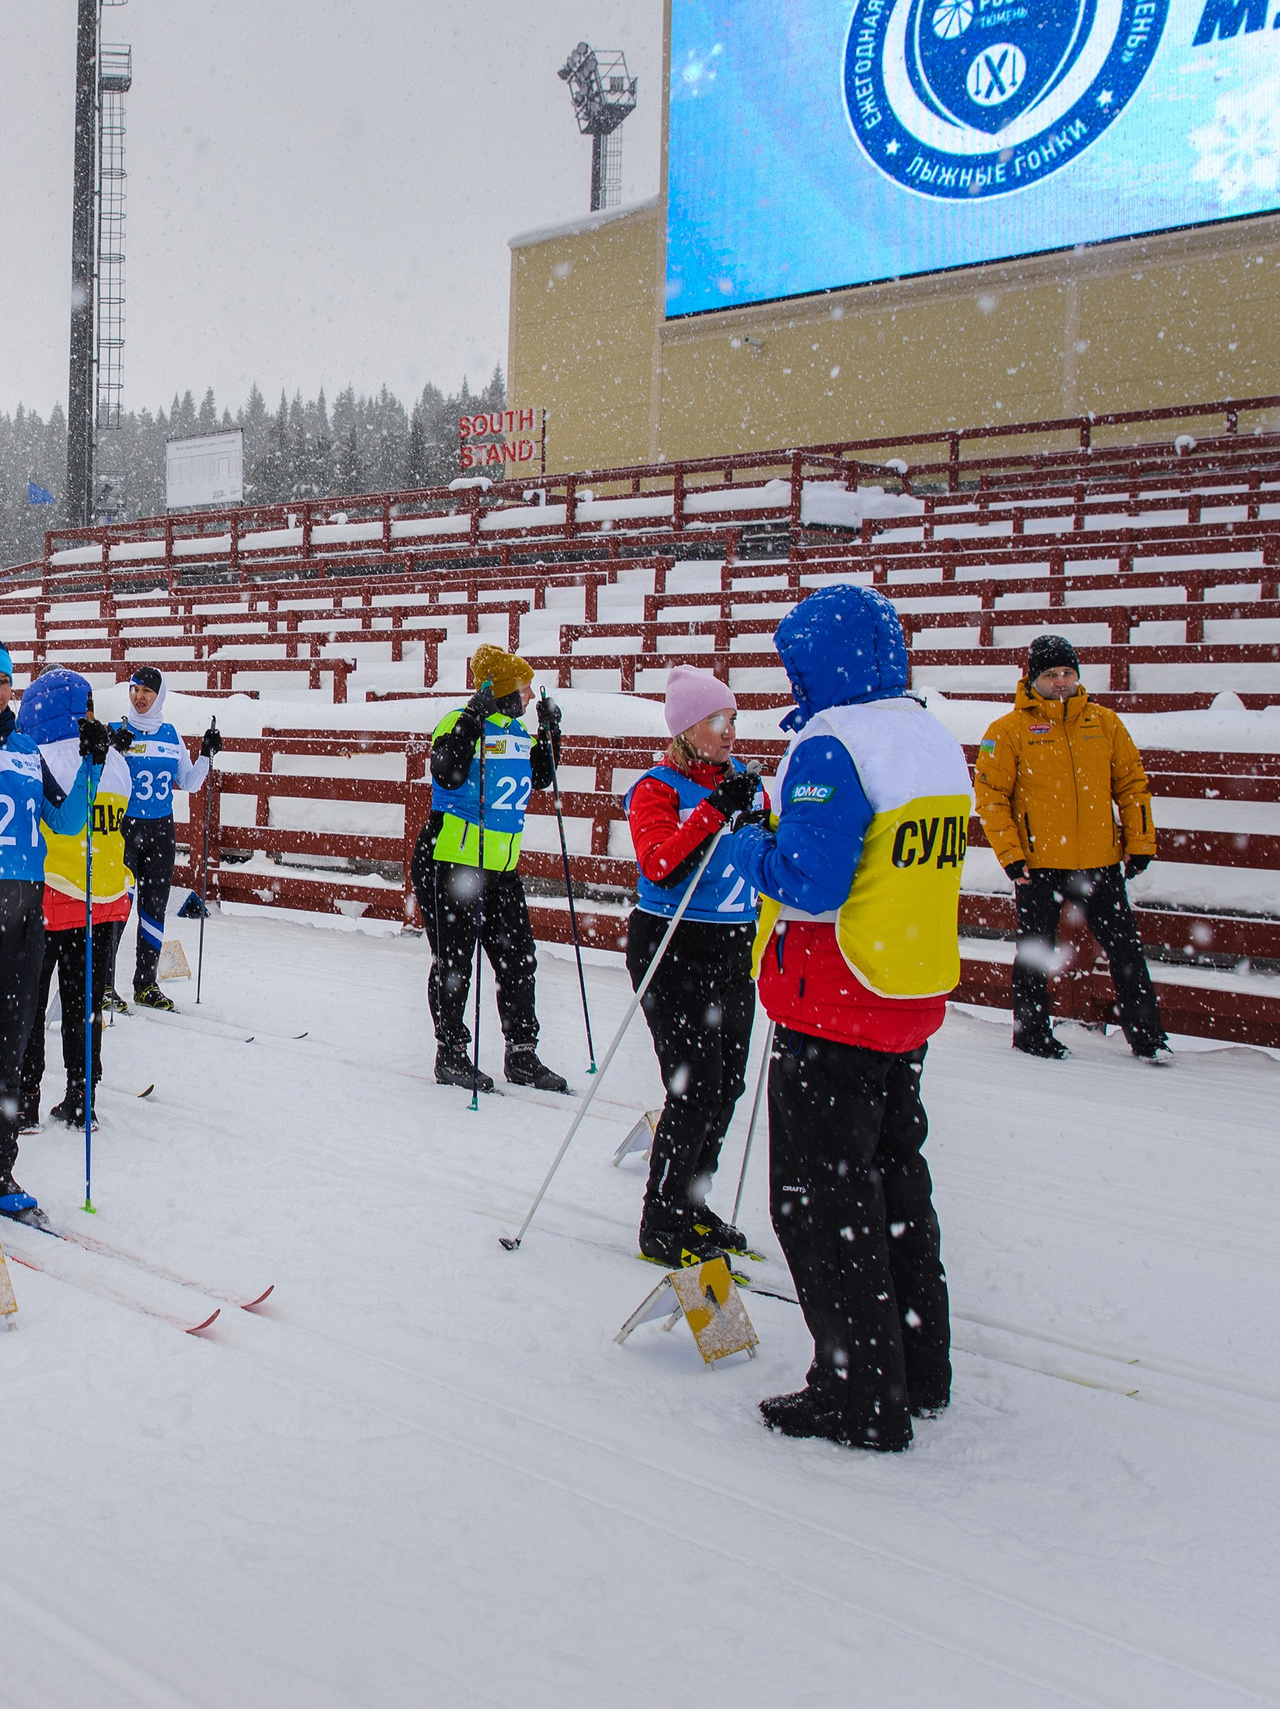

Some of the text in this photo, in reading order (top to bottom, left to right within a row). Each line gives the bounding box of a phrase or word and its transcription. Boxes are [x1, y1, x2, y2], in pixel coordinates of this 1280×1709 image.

[1121, 0, 1157, 63] ЕНЬ»
[906, 117, 1090, 188] ЛЫЖНЫЕ ГОНКИ
[458, 408, 534, 439] SOUTH
[460, 439, 534, 468] STAND
[135, 769, 173, 801] 33
[491, 775, 532, 811] 22
[93, 804, 125, 836] ДЬЯ
[891, 815, 968, 870] СУДЬ
